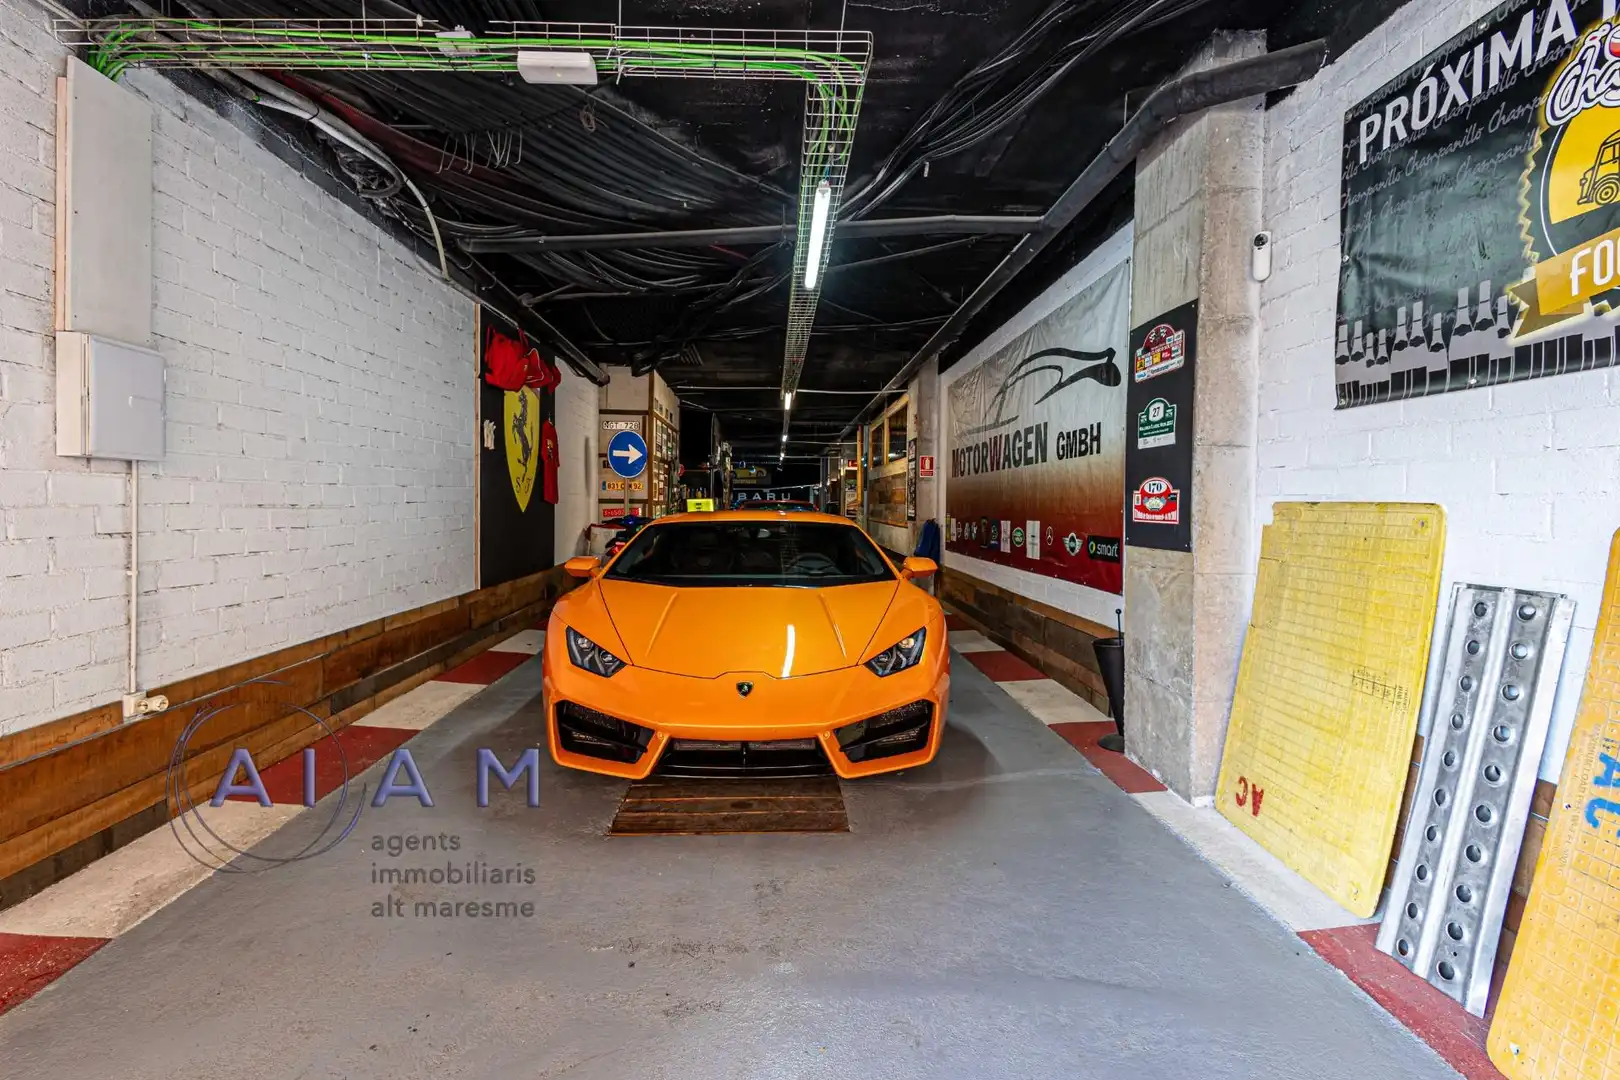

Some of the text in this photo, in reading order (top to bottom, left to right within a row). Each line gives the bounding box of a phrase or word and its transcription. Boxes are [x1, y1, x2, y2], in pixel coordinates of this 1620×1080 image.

[1359, 0, 1577, 165] PRÓXIMA
[1569, 236, 1620, 297] FO
[1152, 406, 1161, 418] 27
[951, 421, 1102, 478] MOTORWAGEN GMBH
[1148, 482, 1163, 493] 170
[1096, 543, 1119, 558] smart
